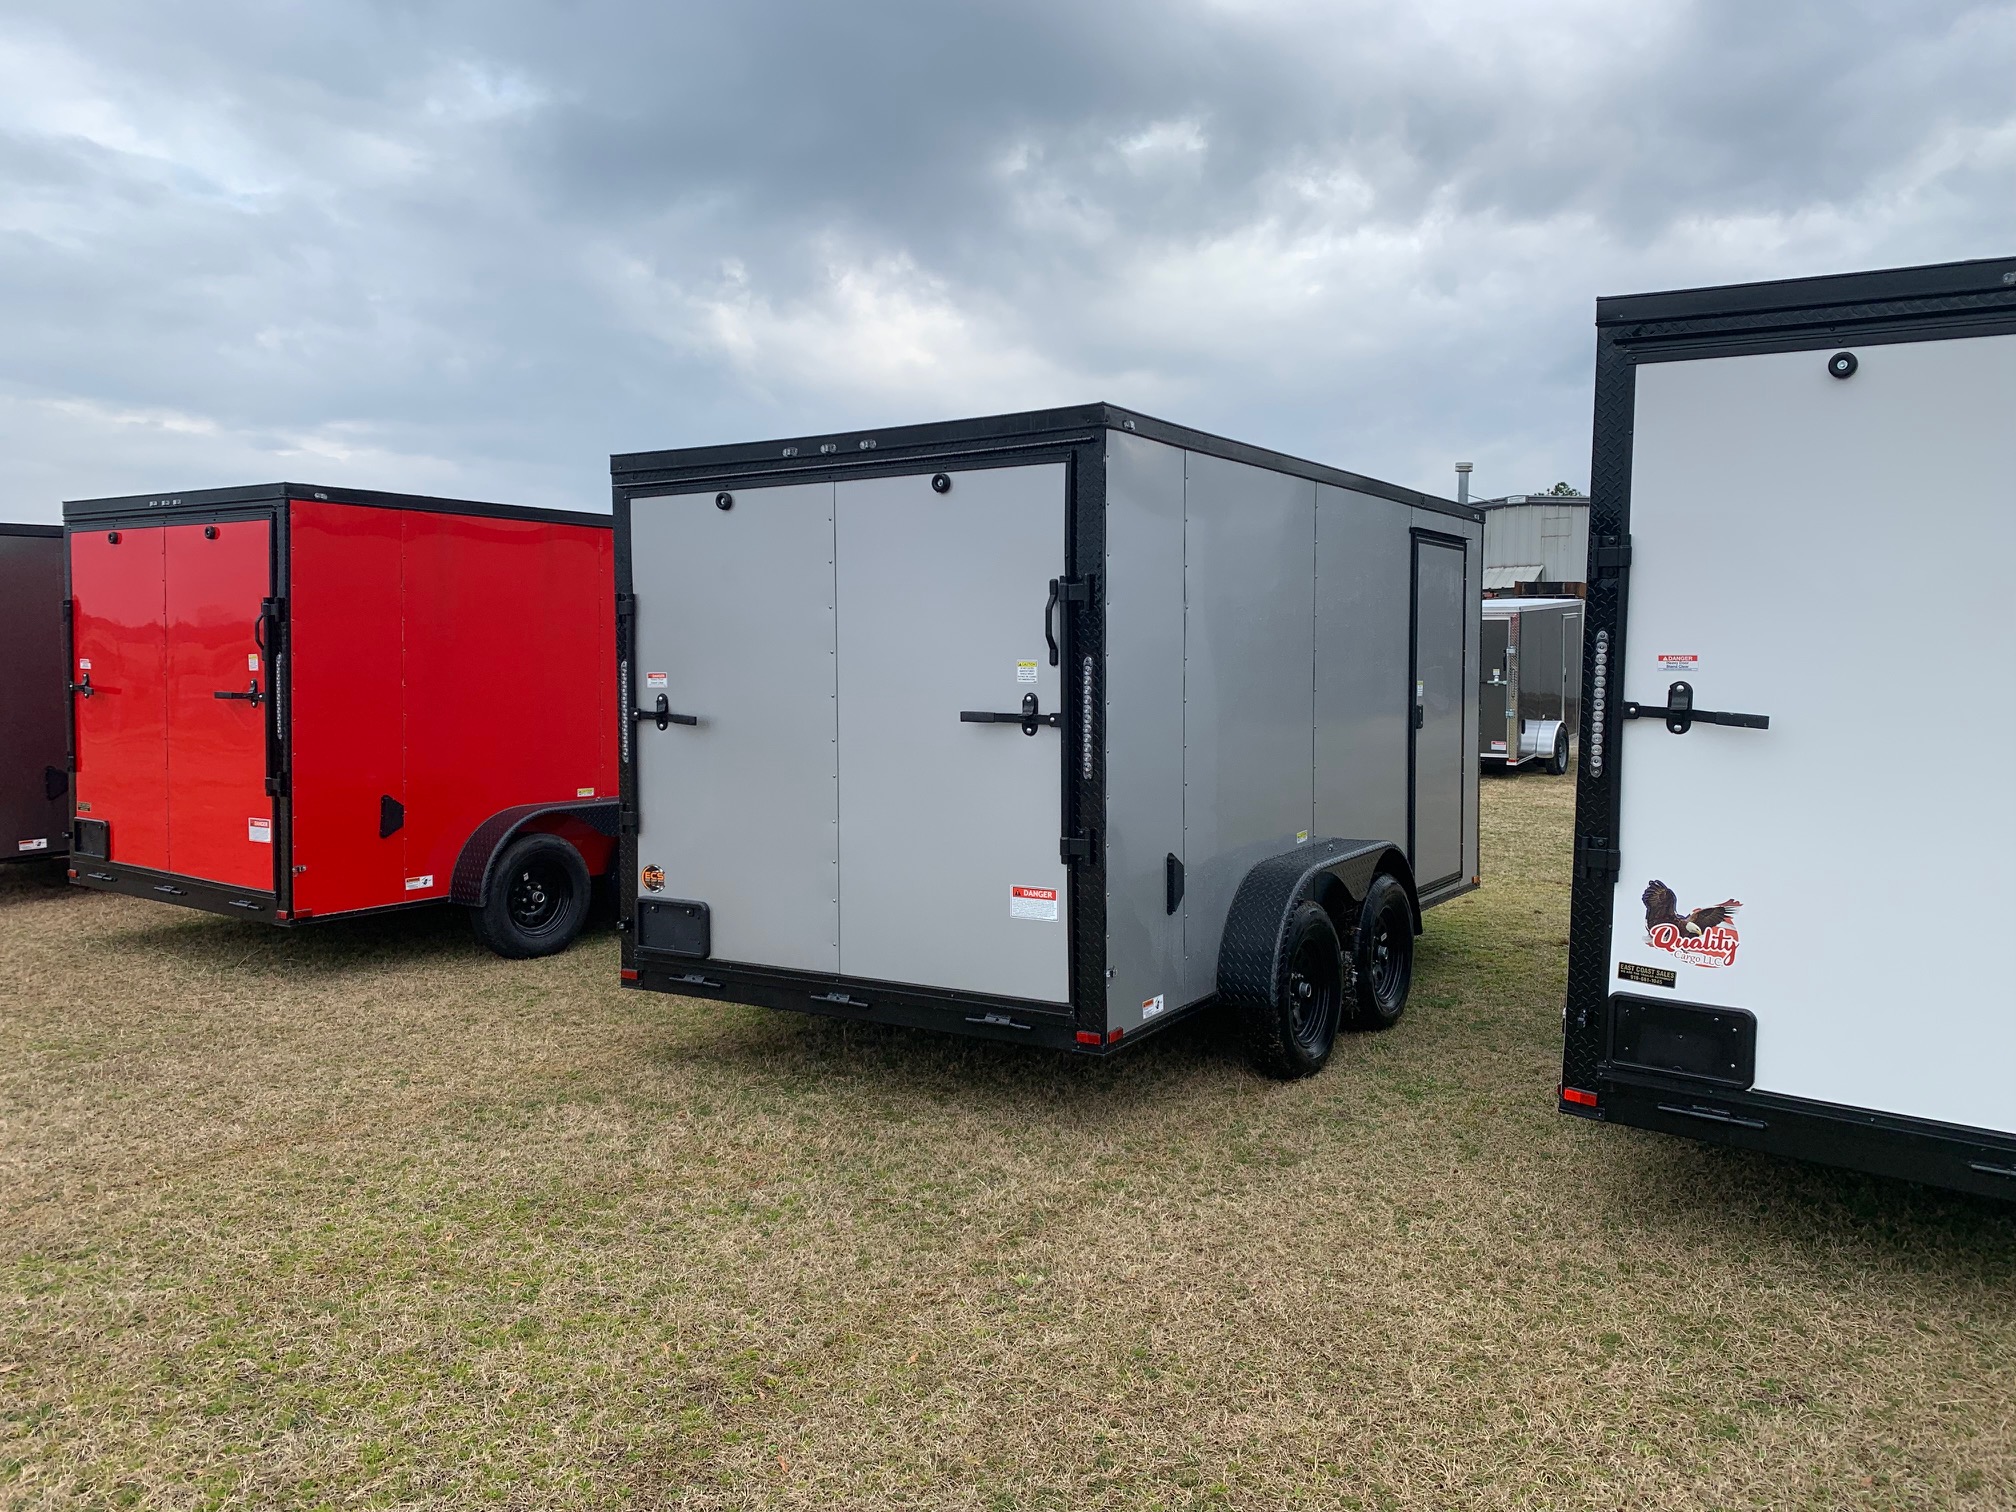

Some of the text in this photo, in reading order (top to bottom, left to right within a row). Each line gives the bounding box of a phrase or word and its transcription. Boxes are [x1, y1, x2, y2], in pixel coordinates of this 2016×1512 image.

[645, 871, 664, 880] ECS
[1023, 889, 1053, 899] DANGER
[1650, 924, 1739, 966] Quality
[1674, 950, 1701, 964] Cargo
[1620, 963, 1675, 978] EAST COAST SALES
